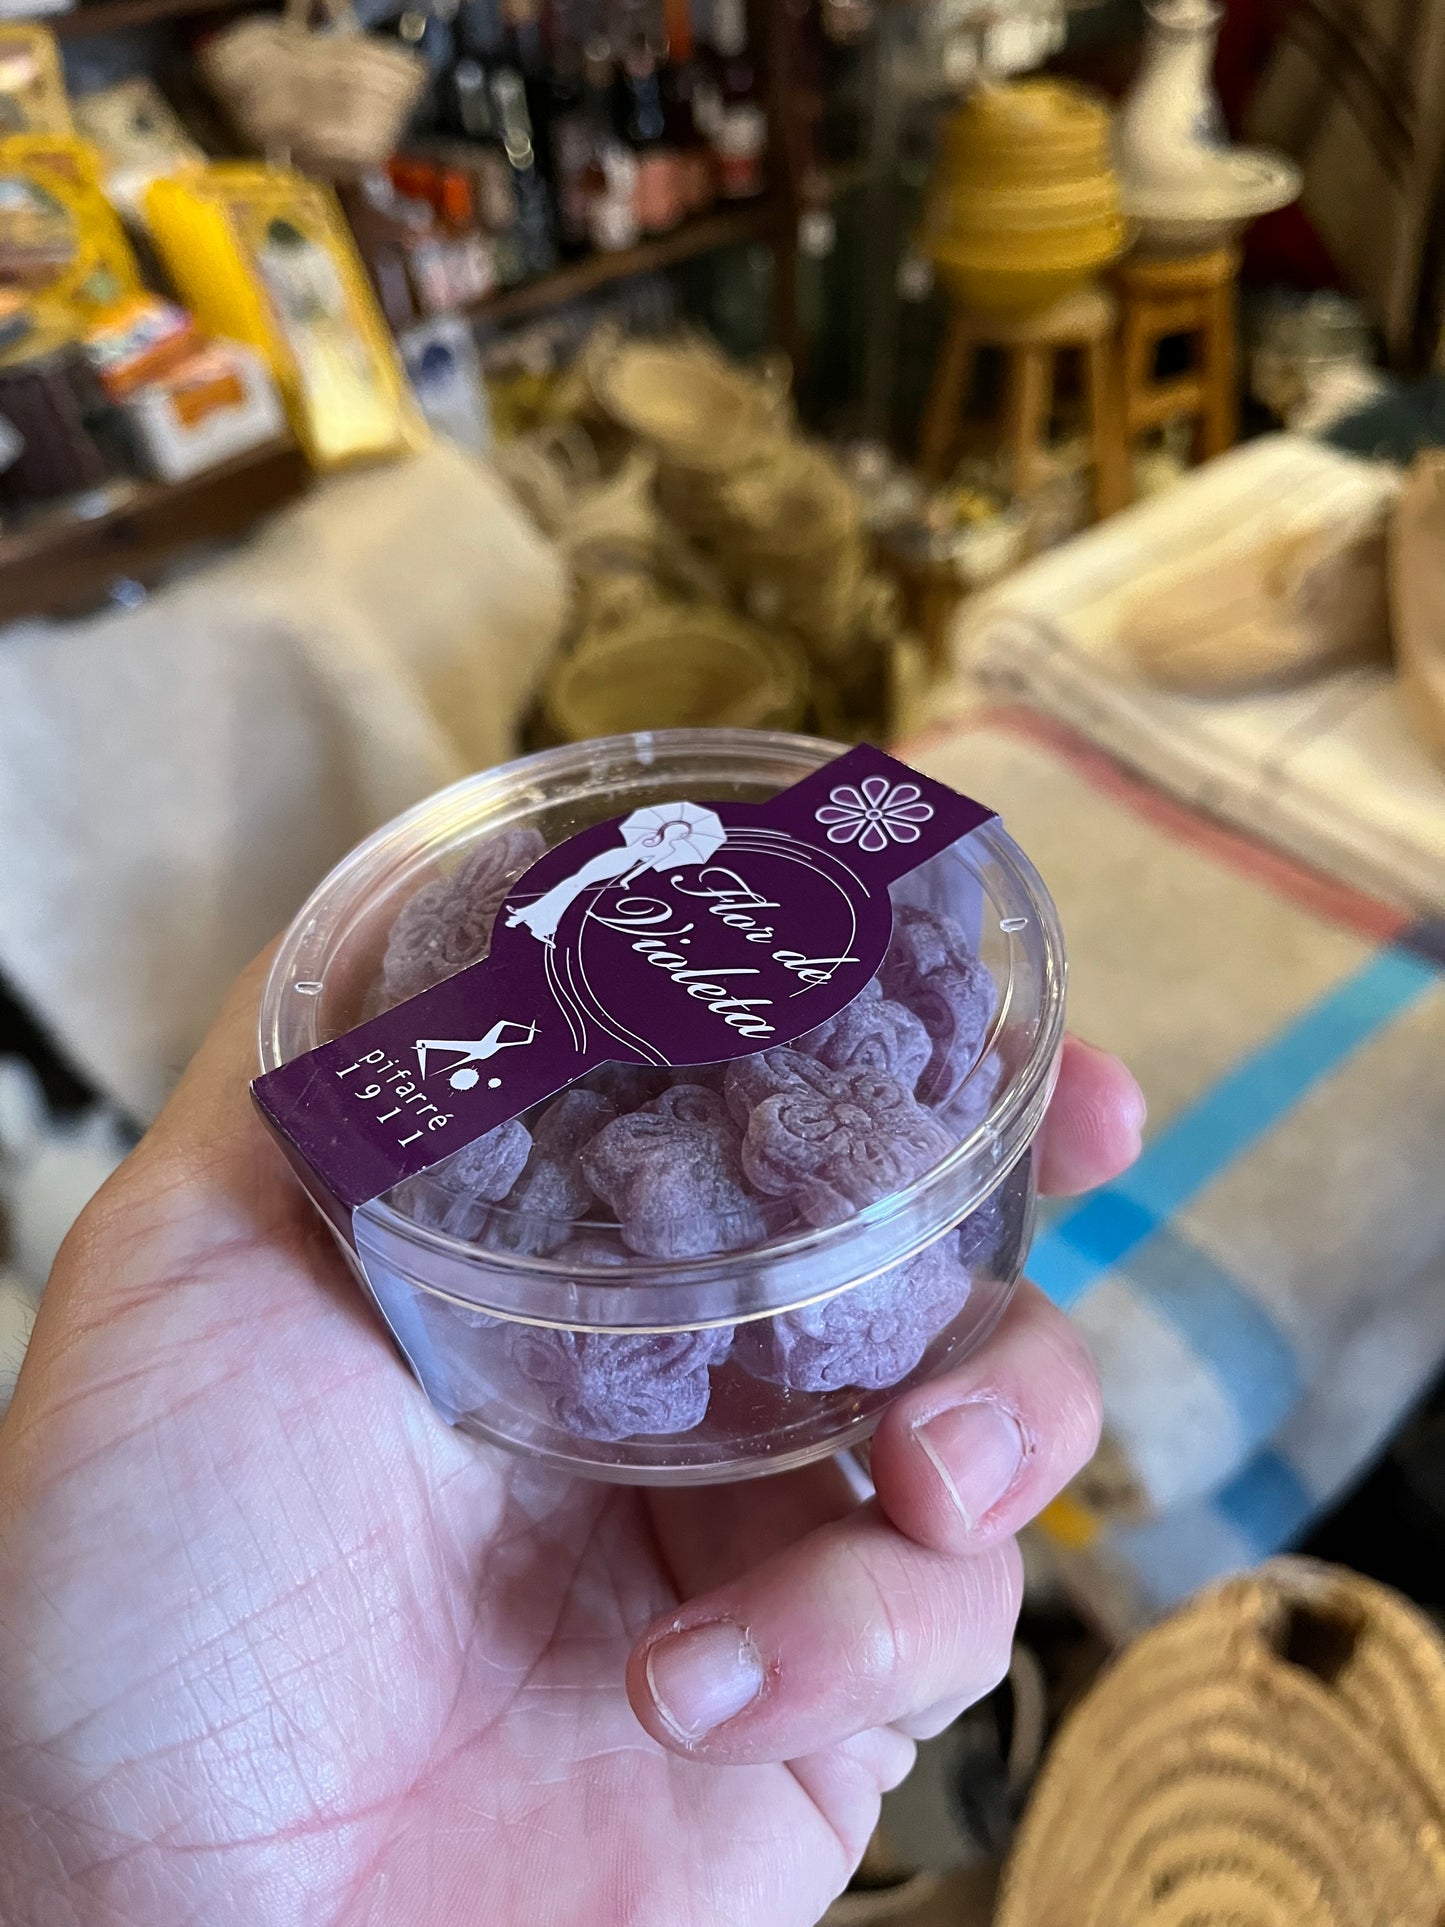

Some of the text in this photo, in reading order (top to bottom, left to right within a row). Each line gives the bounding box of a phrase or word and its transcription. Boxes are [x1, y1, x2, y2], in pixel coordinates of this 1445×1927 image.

[586, 896, 776, 1040] Violeta
[670, 866, 861, 985] Flor de
[358, 1048, 456, 1131] pifarré
